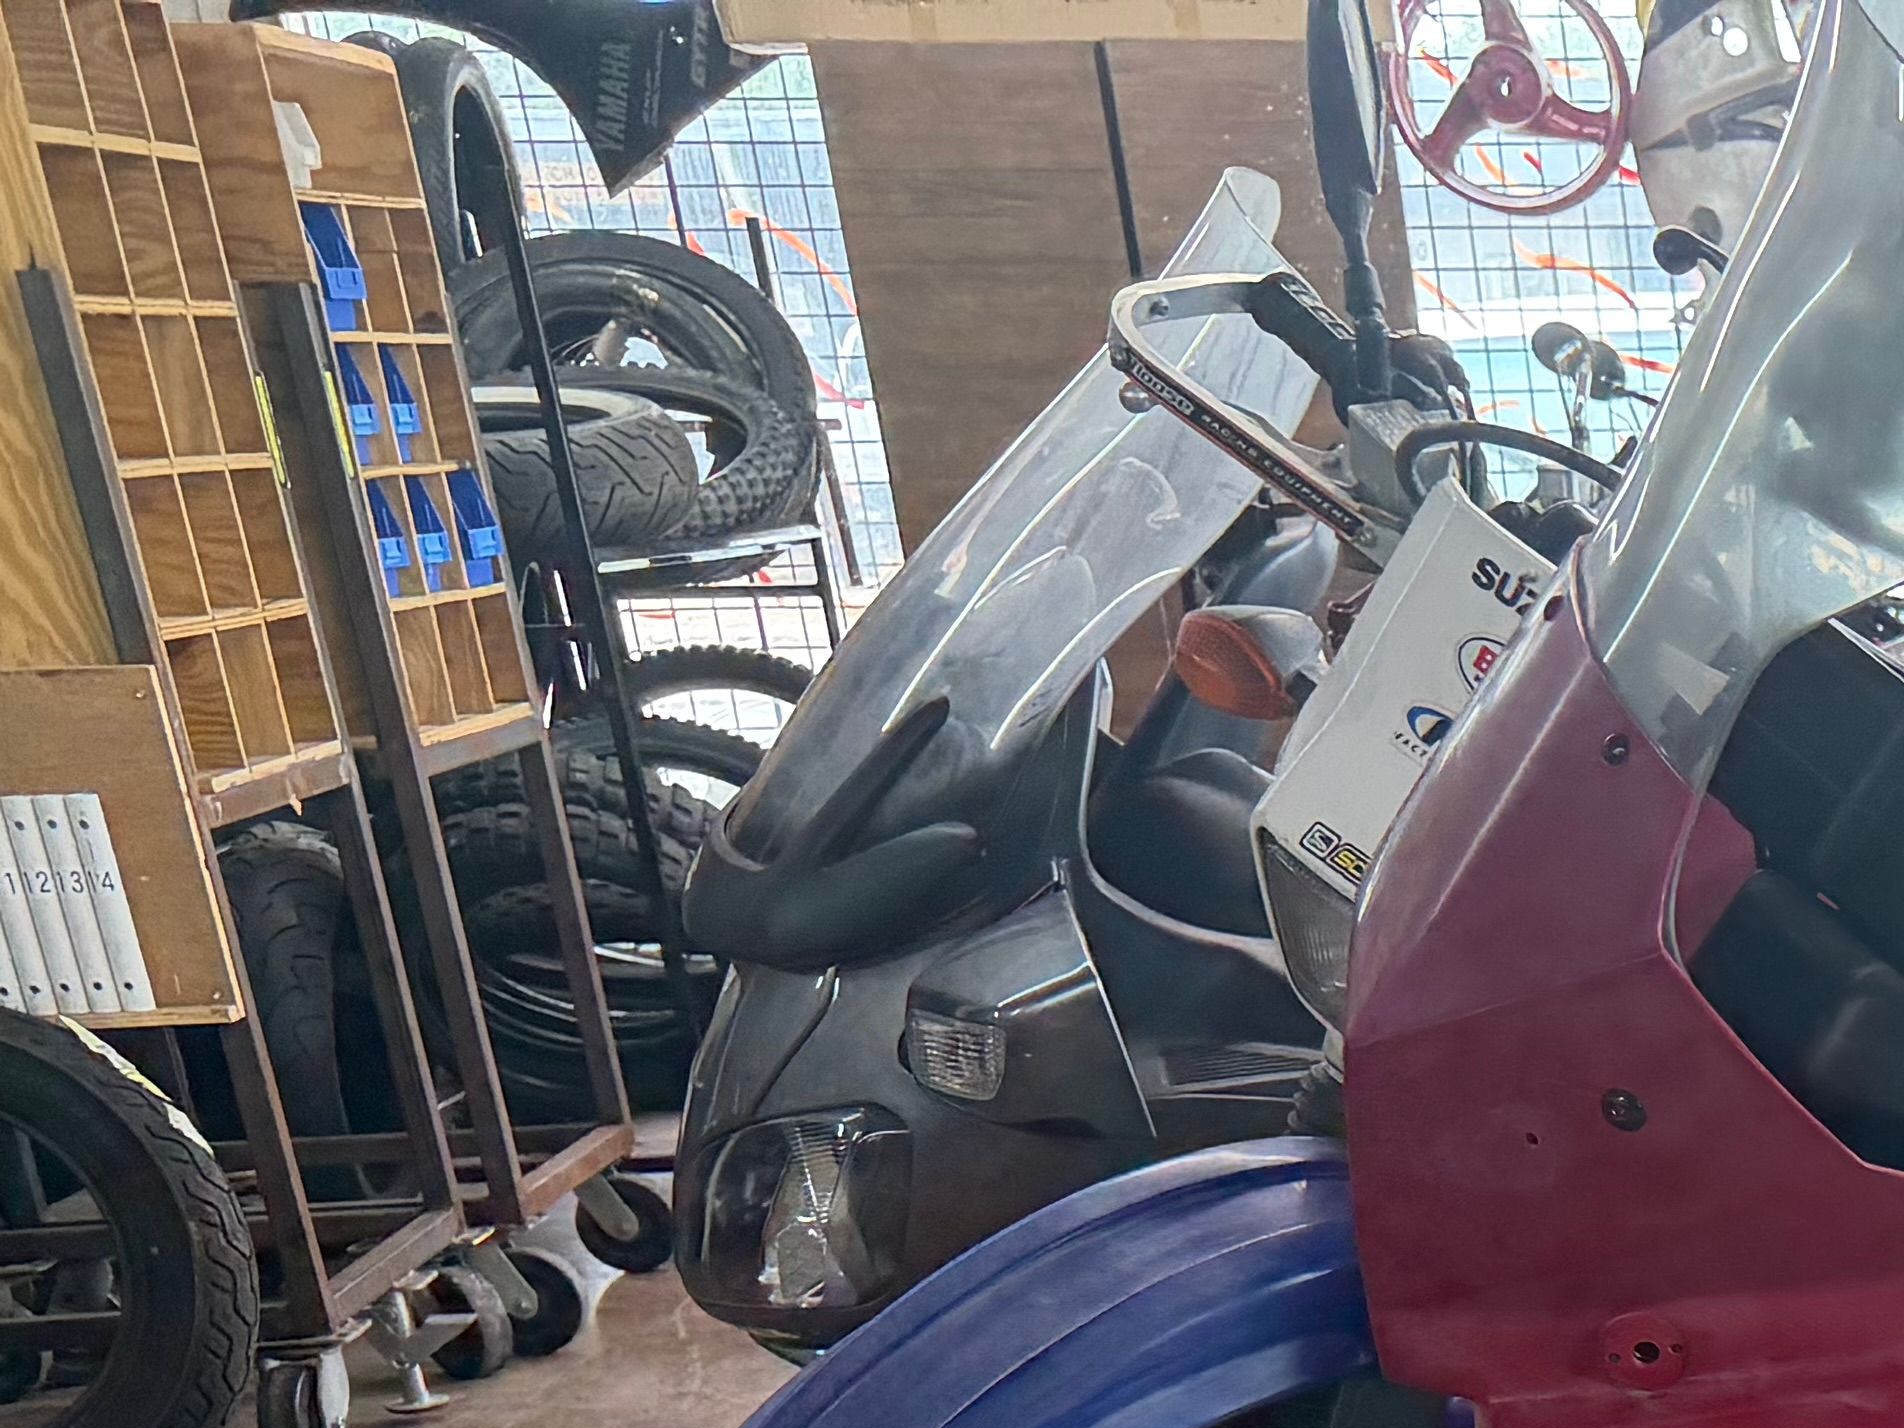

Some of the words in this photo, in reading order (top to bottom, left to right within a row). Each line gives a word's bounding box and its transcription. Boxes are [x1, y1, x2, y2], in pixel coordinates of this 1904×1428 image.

[597, 42, 631, 151] YAMAHA
[1263, 459, 1352, 524] EQUIPMENT
[56, 871, 84, 893] 13
[87, 871, 115, 892] 14
